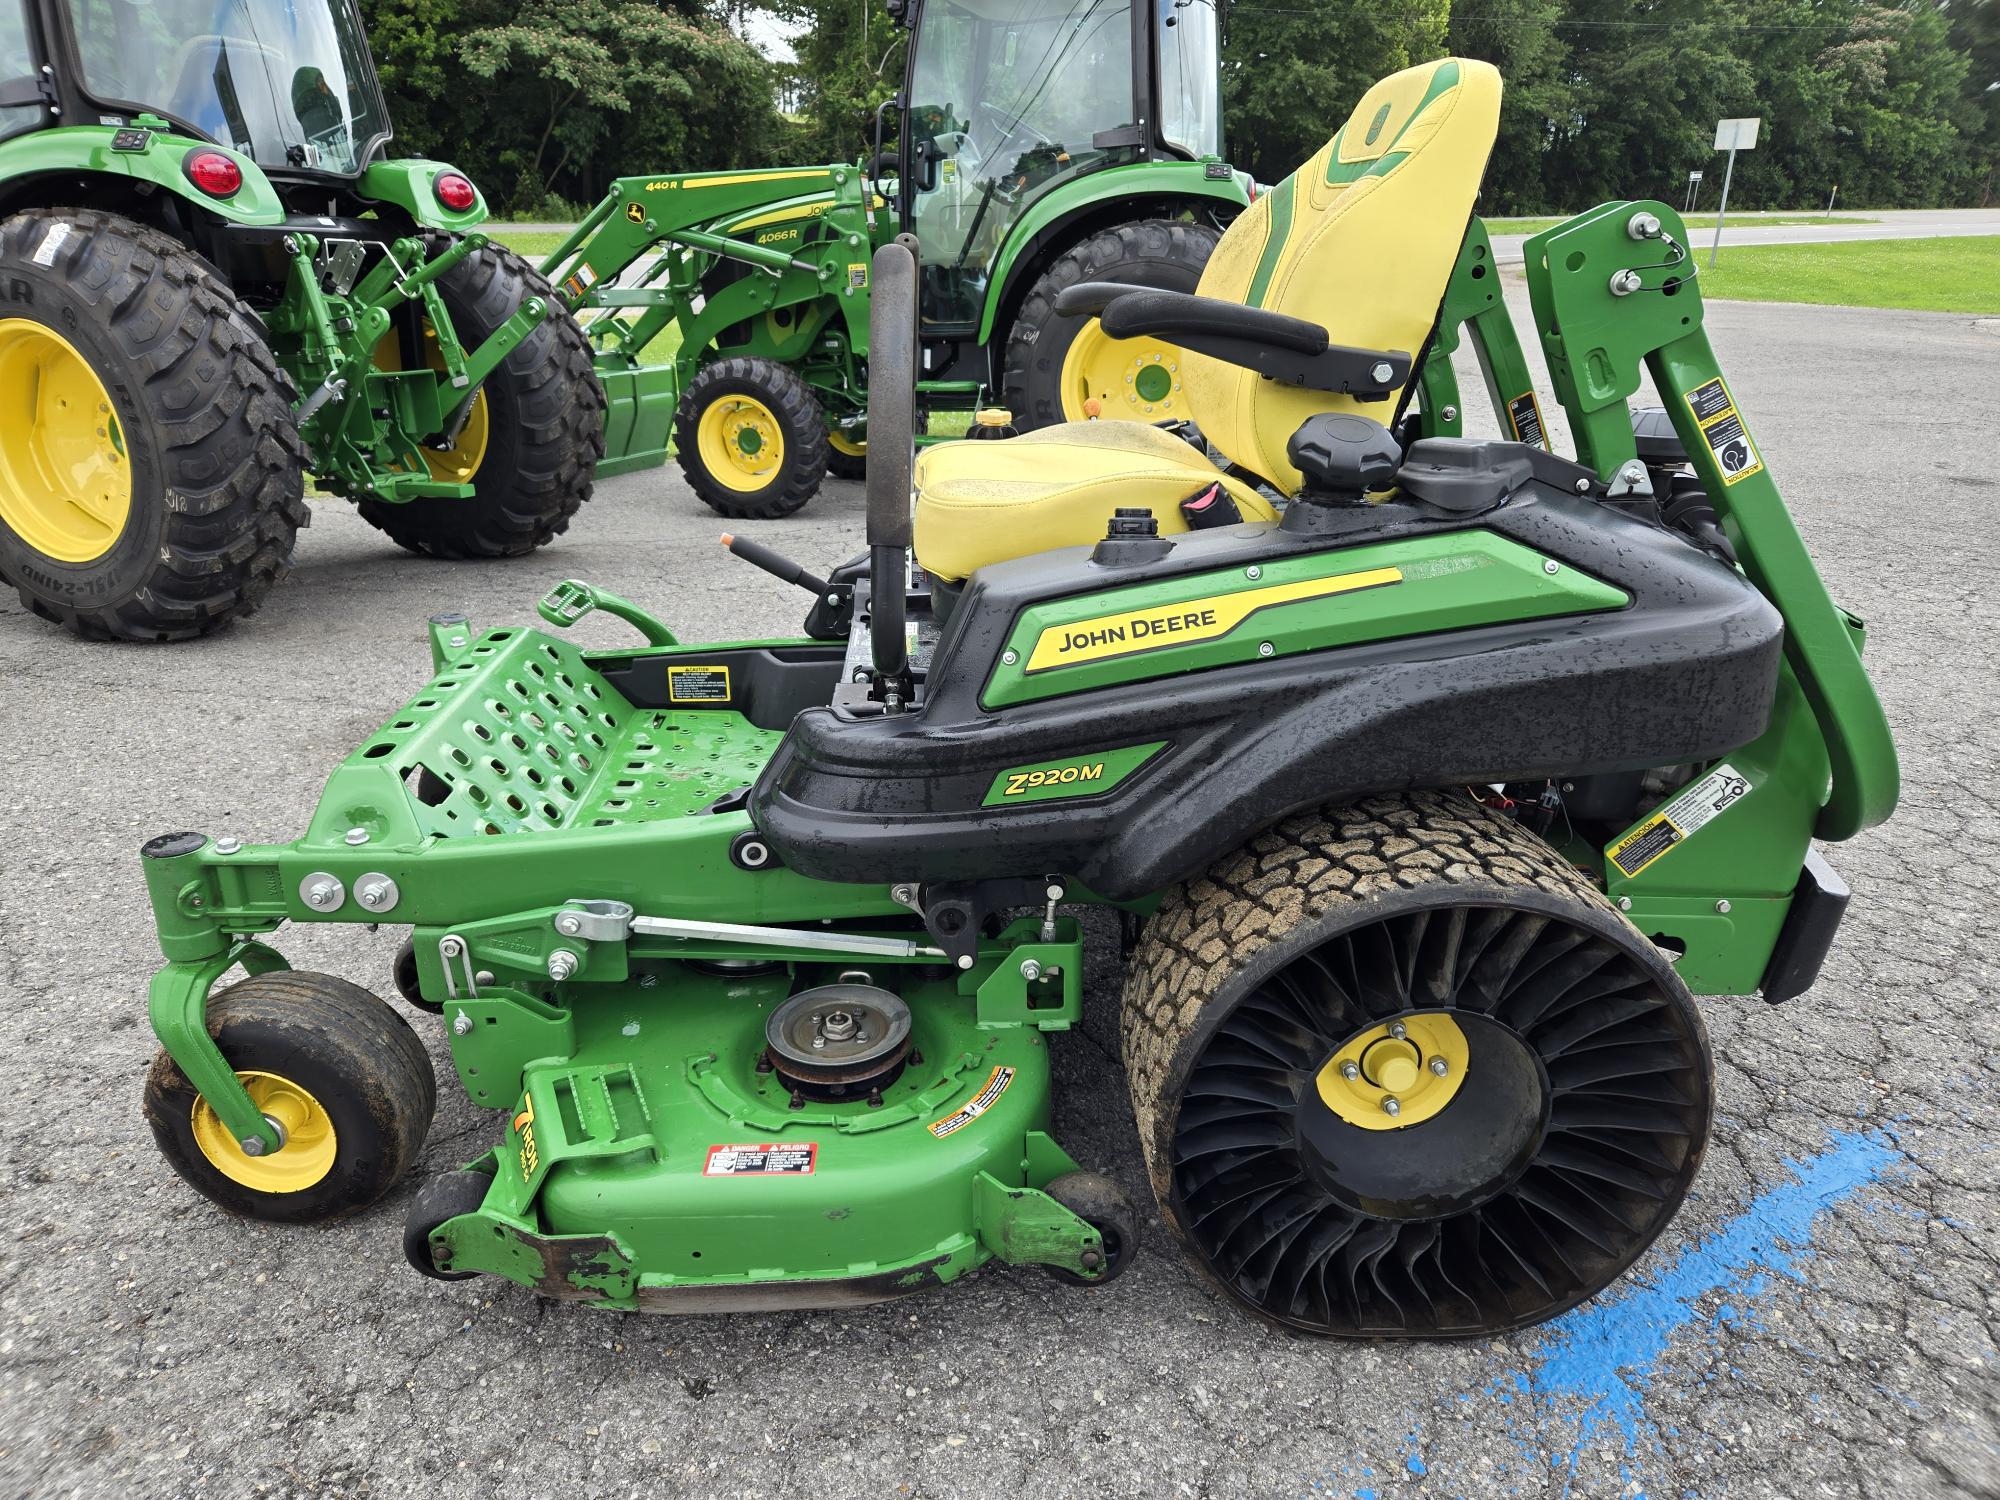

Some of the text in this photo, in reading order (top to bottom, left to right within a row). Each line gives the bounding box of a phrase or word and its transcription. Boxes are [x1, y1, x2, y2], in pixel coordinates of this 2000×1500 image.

[1059, 609, 1217, 653] JOHN DEERE
[1004, 764, 1104, 795] Z920M
[1623, 822, 1655, 847] ATENCIÓN
